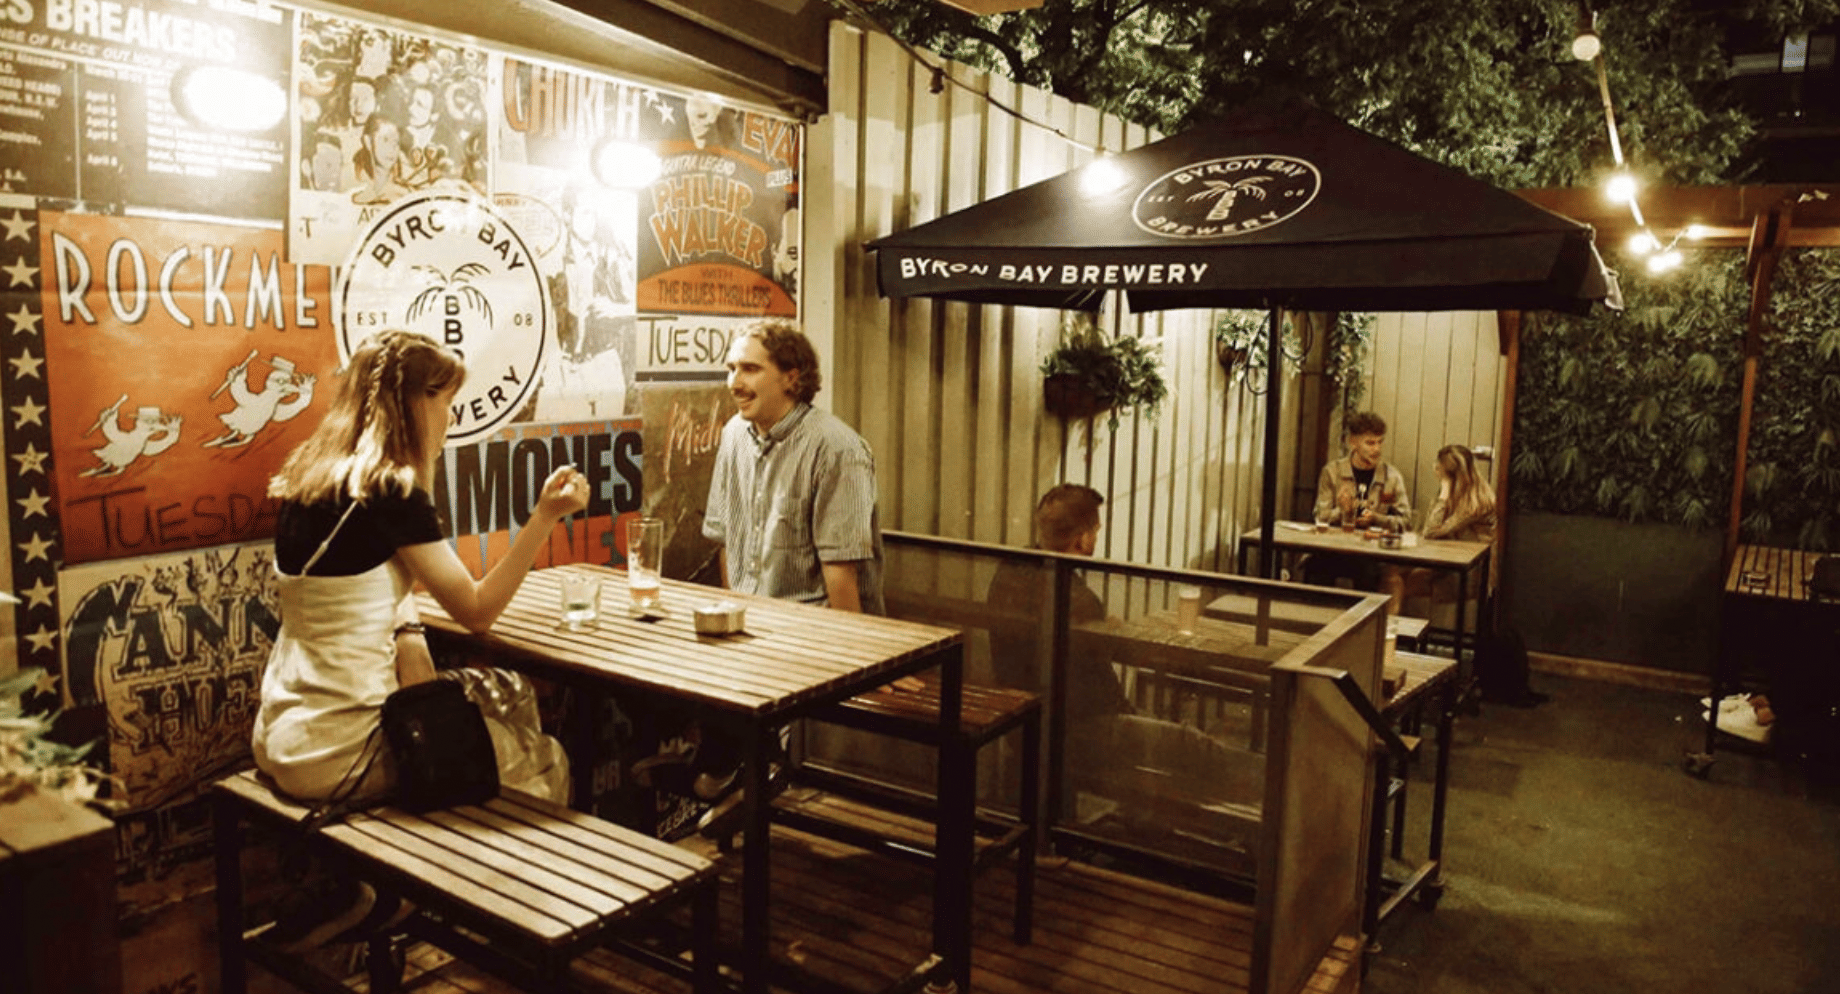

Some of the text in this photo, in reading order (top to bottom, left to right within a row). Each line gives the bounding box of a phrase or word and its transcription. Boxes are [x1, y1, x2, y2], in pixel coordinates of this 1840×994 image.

[47, 0, 237, 62] BREAKERS
[51, 36, 98, 57] PLACE
[102, 46, 131, 62] OUT
[651, 173, 754, 216] PHILLIP
[1173, 158, 1308, 185] BYRON BAY
[371, 208, 467, 269] BYRO
[477, 222, 525, 271] BAY
[649, 207, 768, 269] WALKER
[1147, 210, 1279, 236] BREWERY
[52, 231, 338, 331] ROCKME
[658, 278, 681, 305] THE
[682, 280, 715, 306] BLUES
[900, 257, 1208, 285] BYRON BAY BREWERY
[513, 313, 534, 327] 08
[433, 430, 643, 541] MONES
[65, 484, 277, 551] TUESD
[65, 573, 284, 725] CANN
